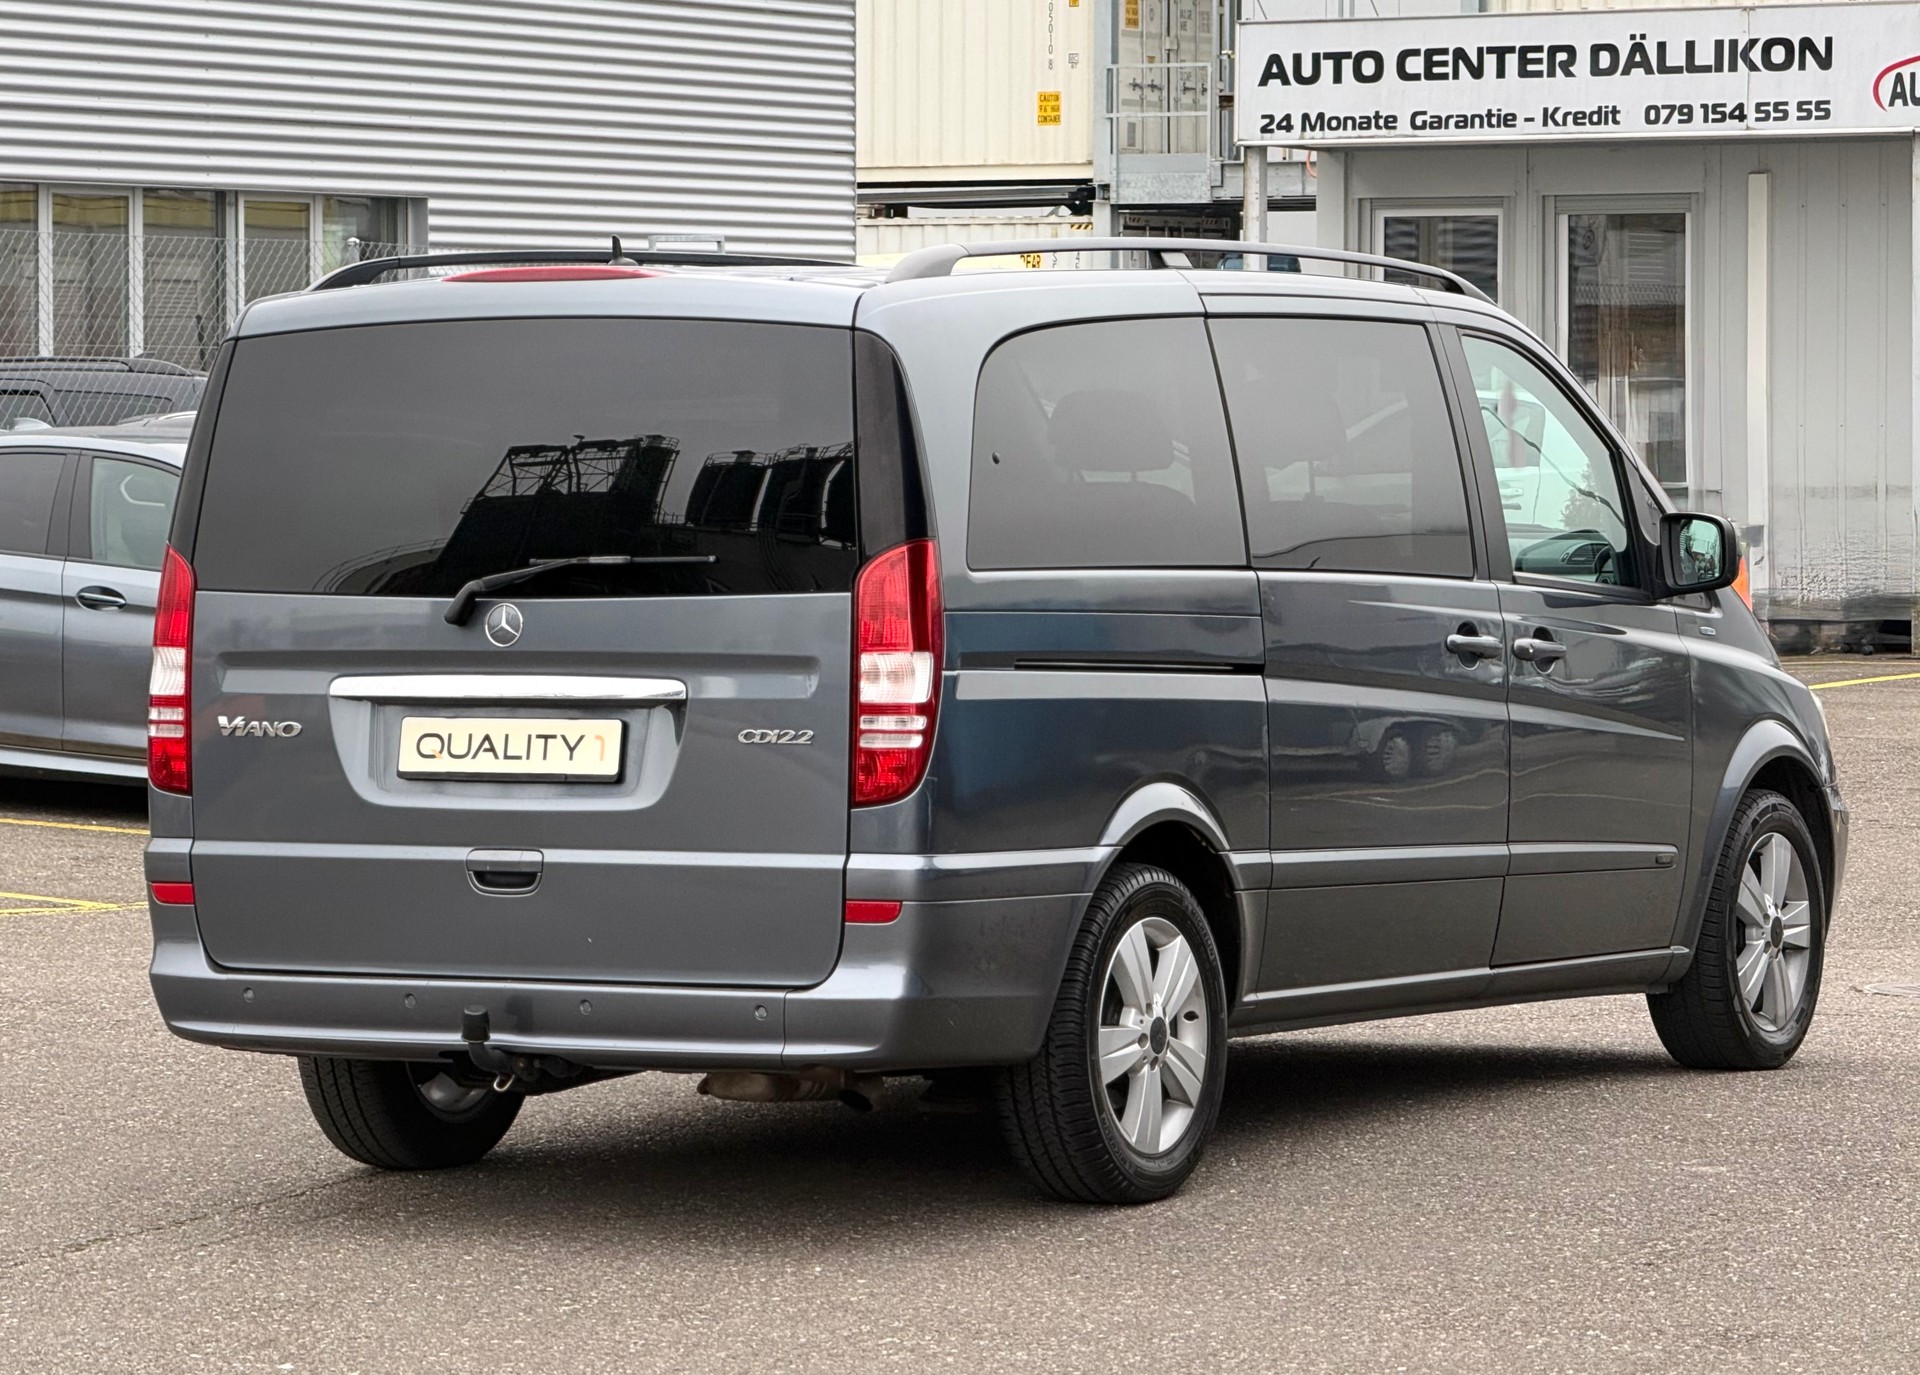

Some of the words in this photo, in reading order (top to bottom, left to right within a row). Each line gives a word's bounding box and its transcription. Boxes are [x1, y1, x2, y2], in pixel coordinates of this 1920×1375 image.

[1258, 51, 1385, 87] AUTO
[1396, 44, 1577, 82] CENTER
[1589, 33, 1833, 77] DÄLLIKON
[1259, 113, 1294, 134] 24
[1301, 110, 1398, 132] Monate
[1409, 108, 1518, 130] Garantie
[1542, 105, 1621, 127] Kredit
[1644, 103, 1694, 126] 079
[1700, 102, 1747, 124] 154
[1754, 101, 1790, 122] 55
[1796, 99, 1831, 121] 55
[416, 732, 586, 761] QUALITY
[594, 734, 605, 761] 1
